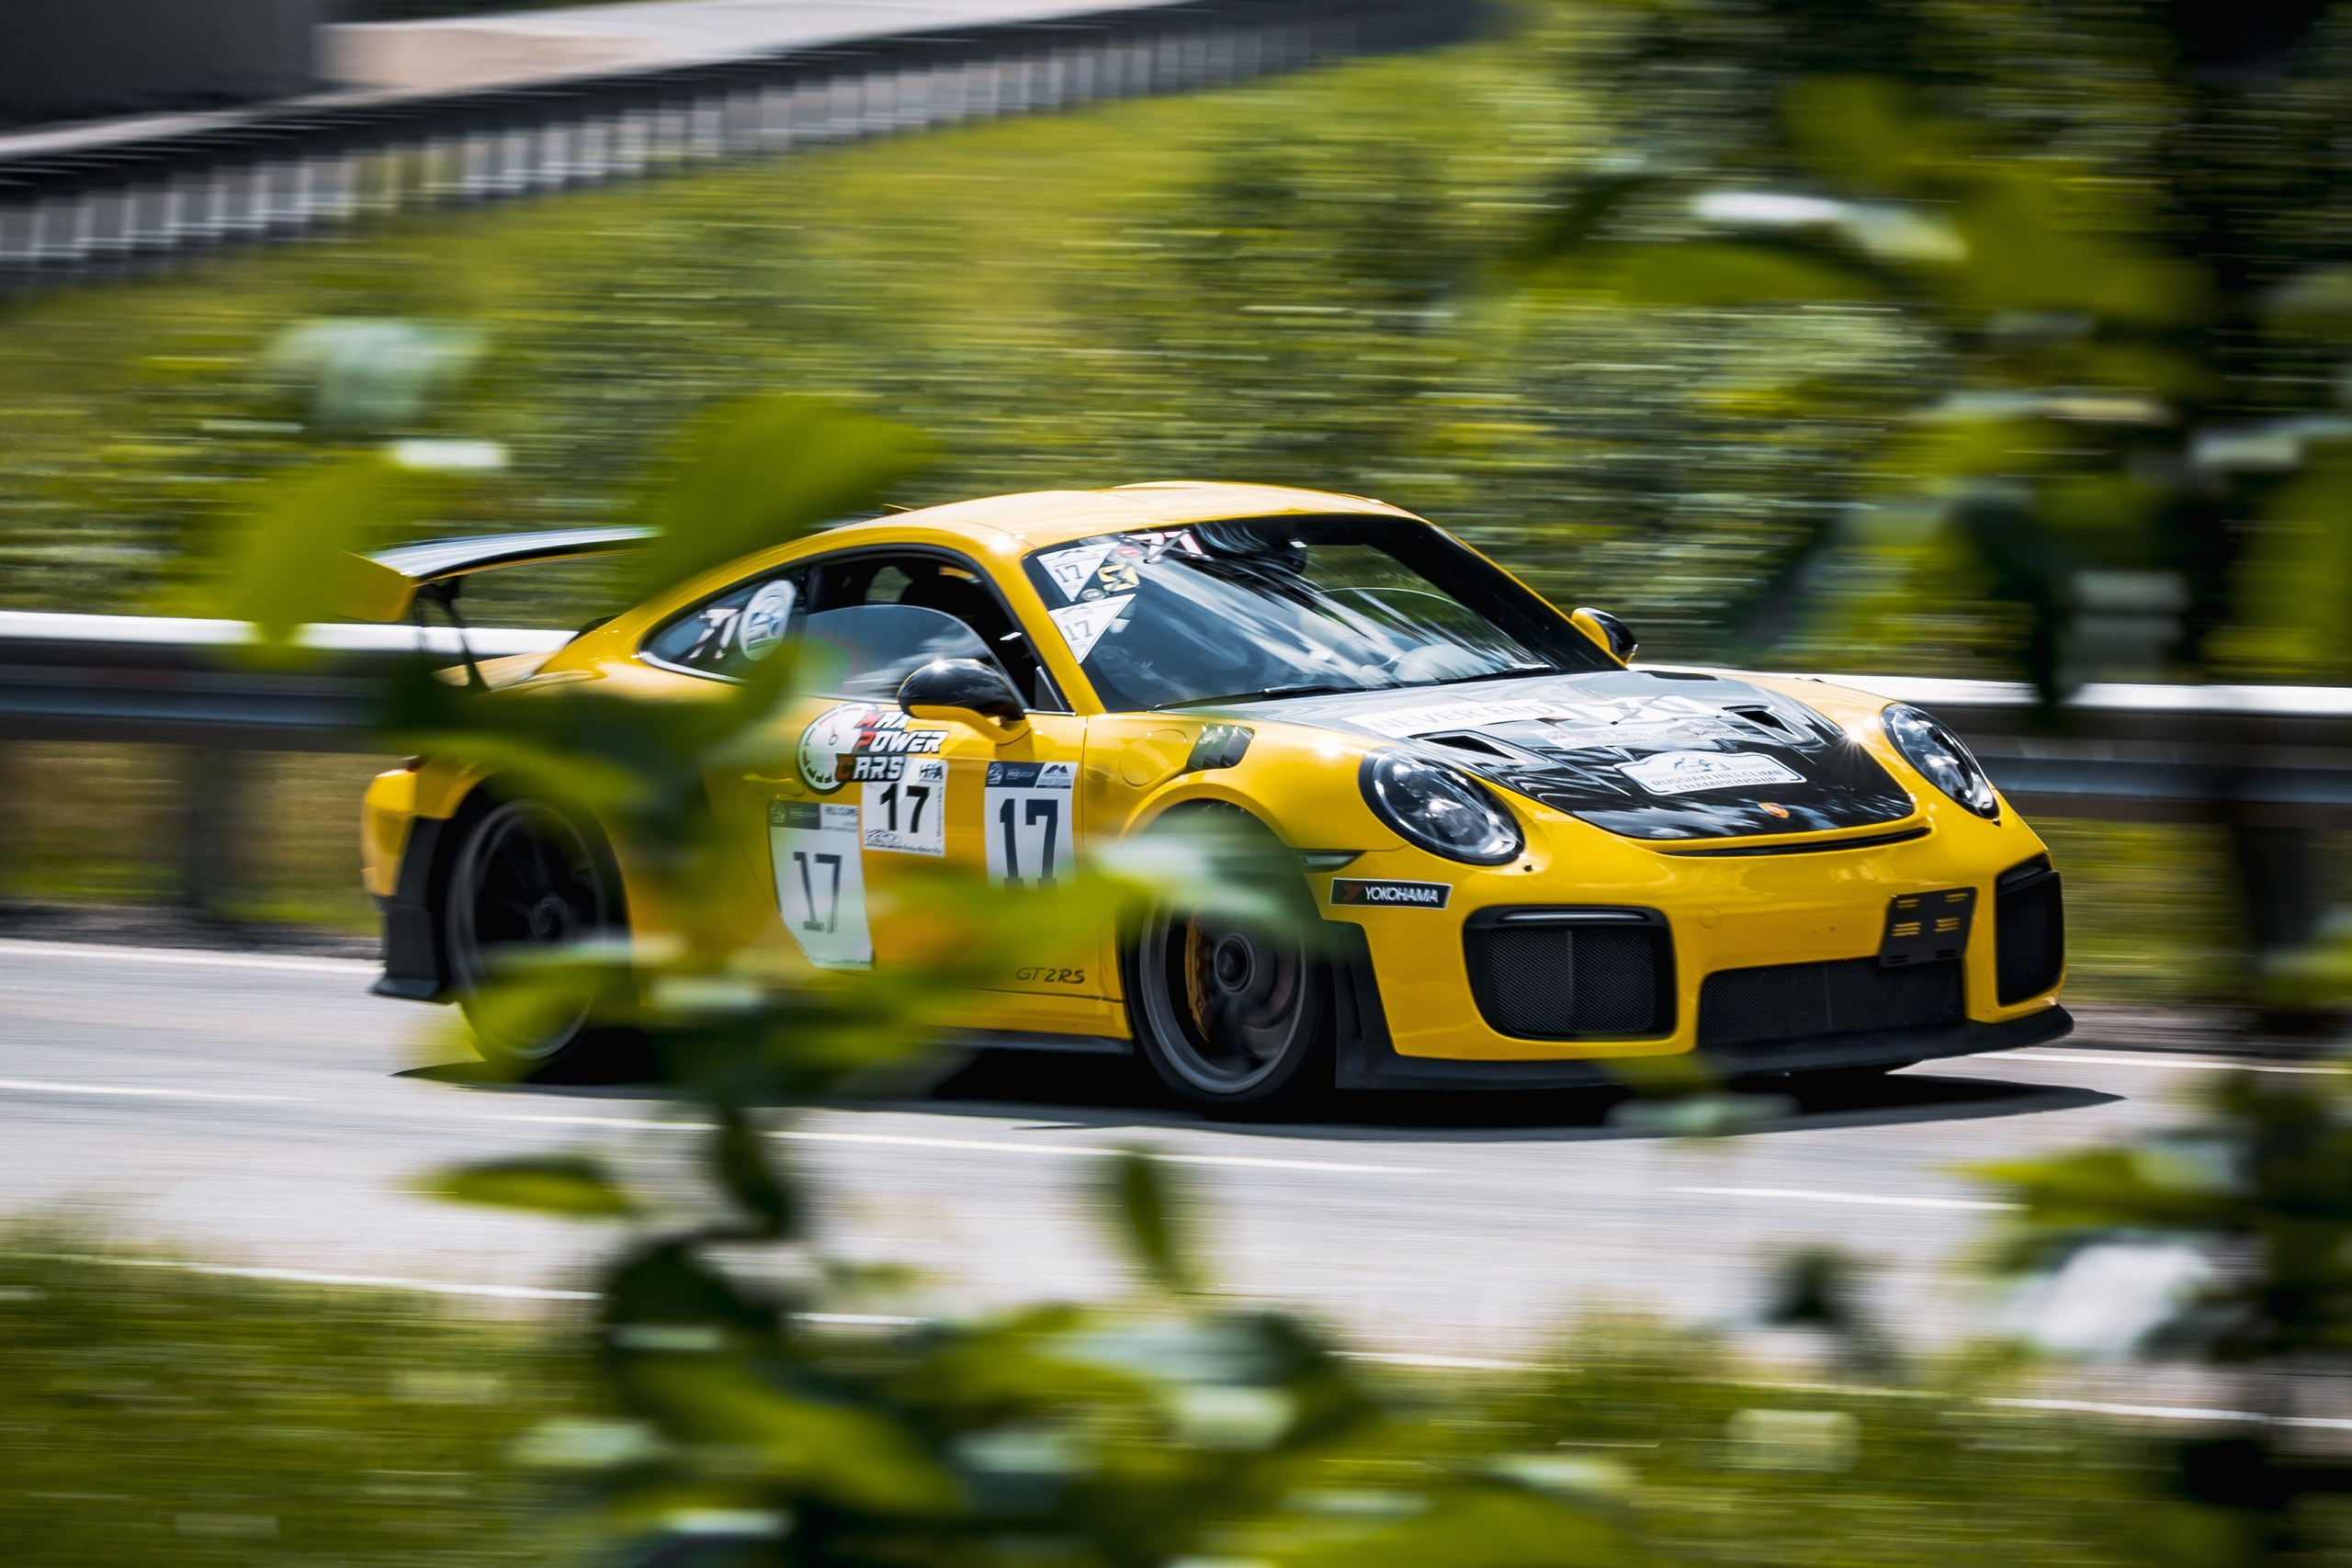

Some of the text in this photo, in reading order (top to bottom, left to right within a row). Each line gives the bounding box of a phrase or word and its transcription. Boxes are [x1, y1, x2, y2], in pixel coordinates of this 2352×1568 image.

[1055, 564, 1083, 582] 17
[1064, 620, 1092, 641] 17
[854, 730, 948, 752] POWER
[836, 755, 904, 781] CARS
[879, 783, 931, 834] 17
[1000, 798, 1059, 889] 17
[794, 852, 842, 934] 17
[1365, 886, 1439, 903] YOKOHAMA
